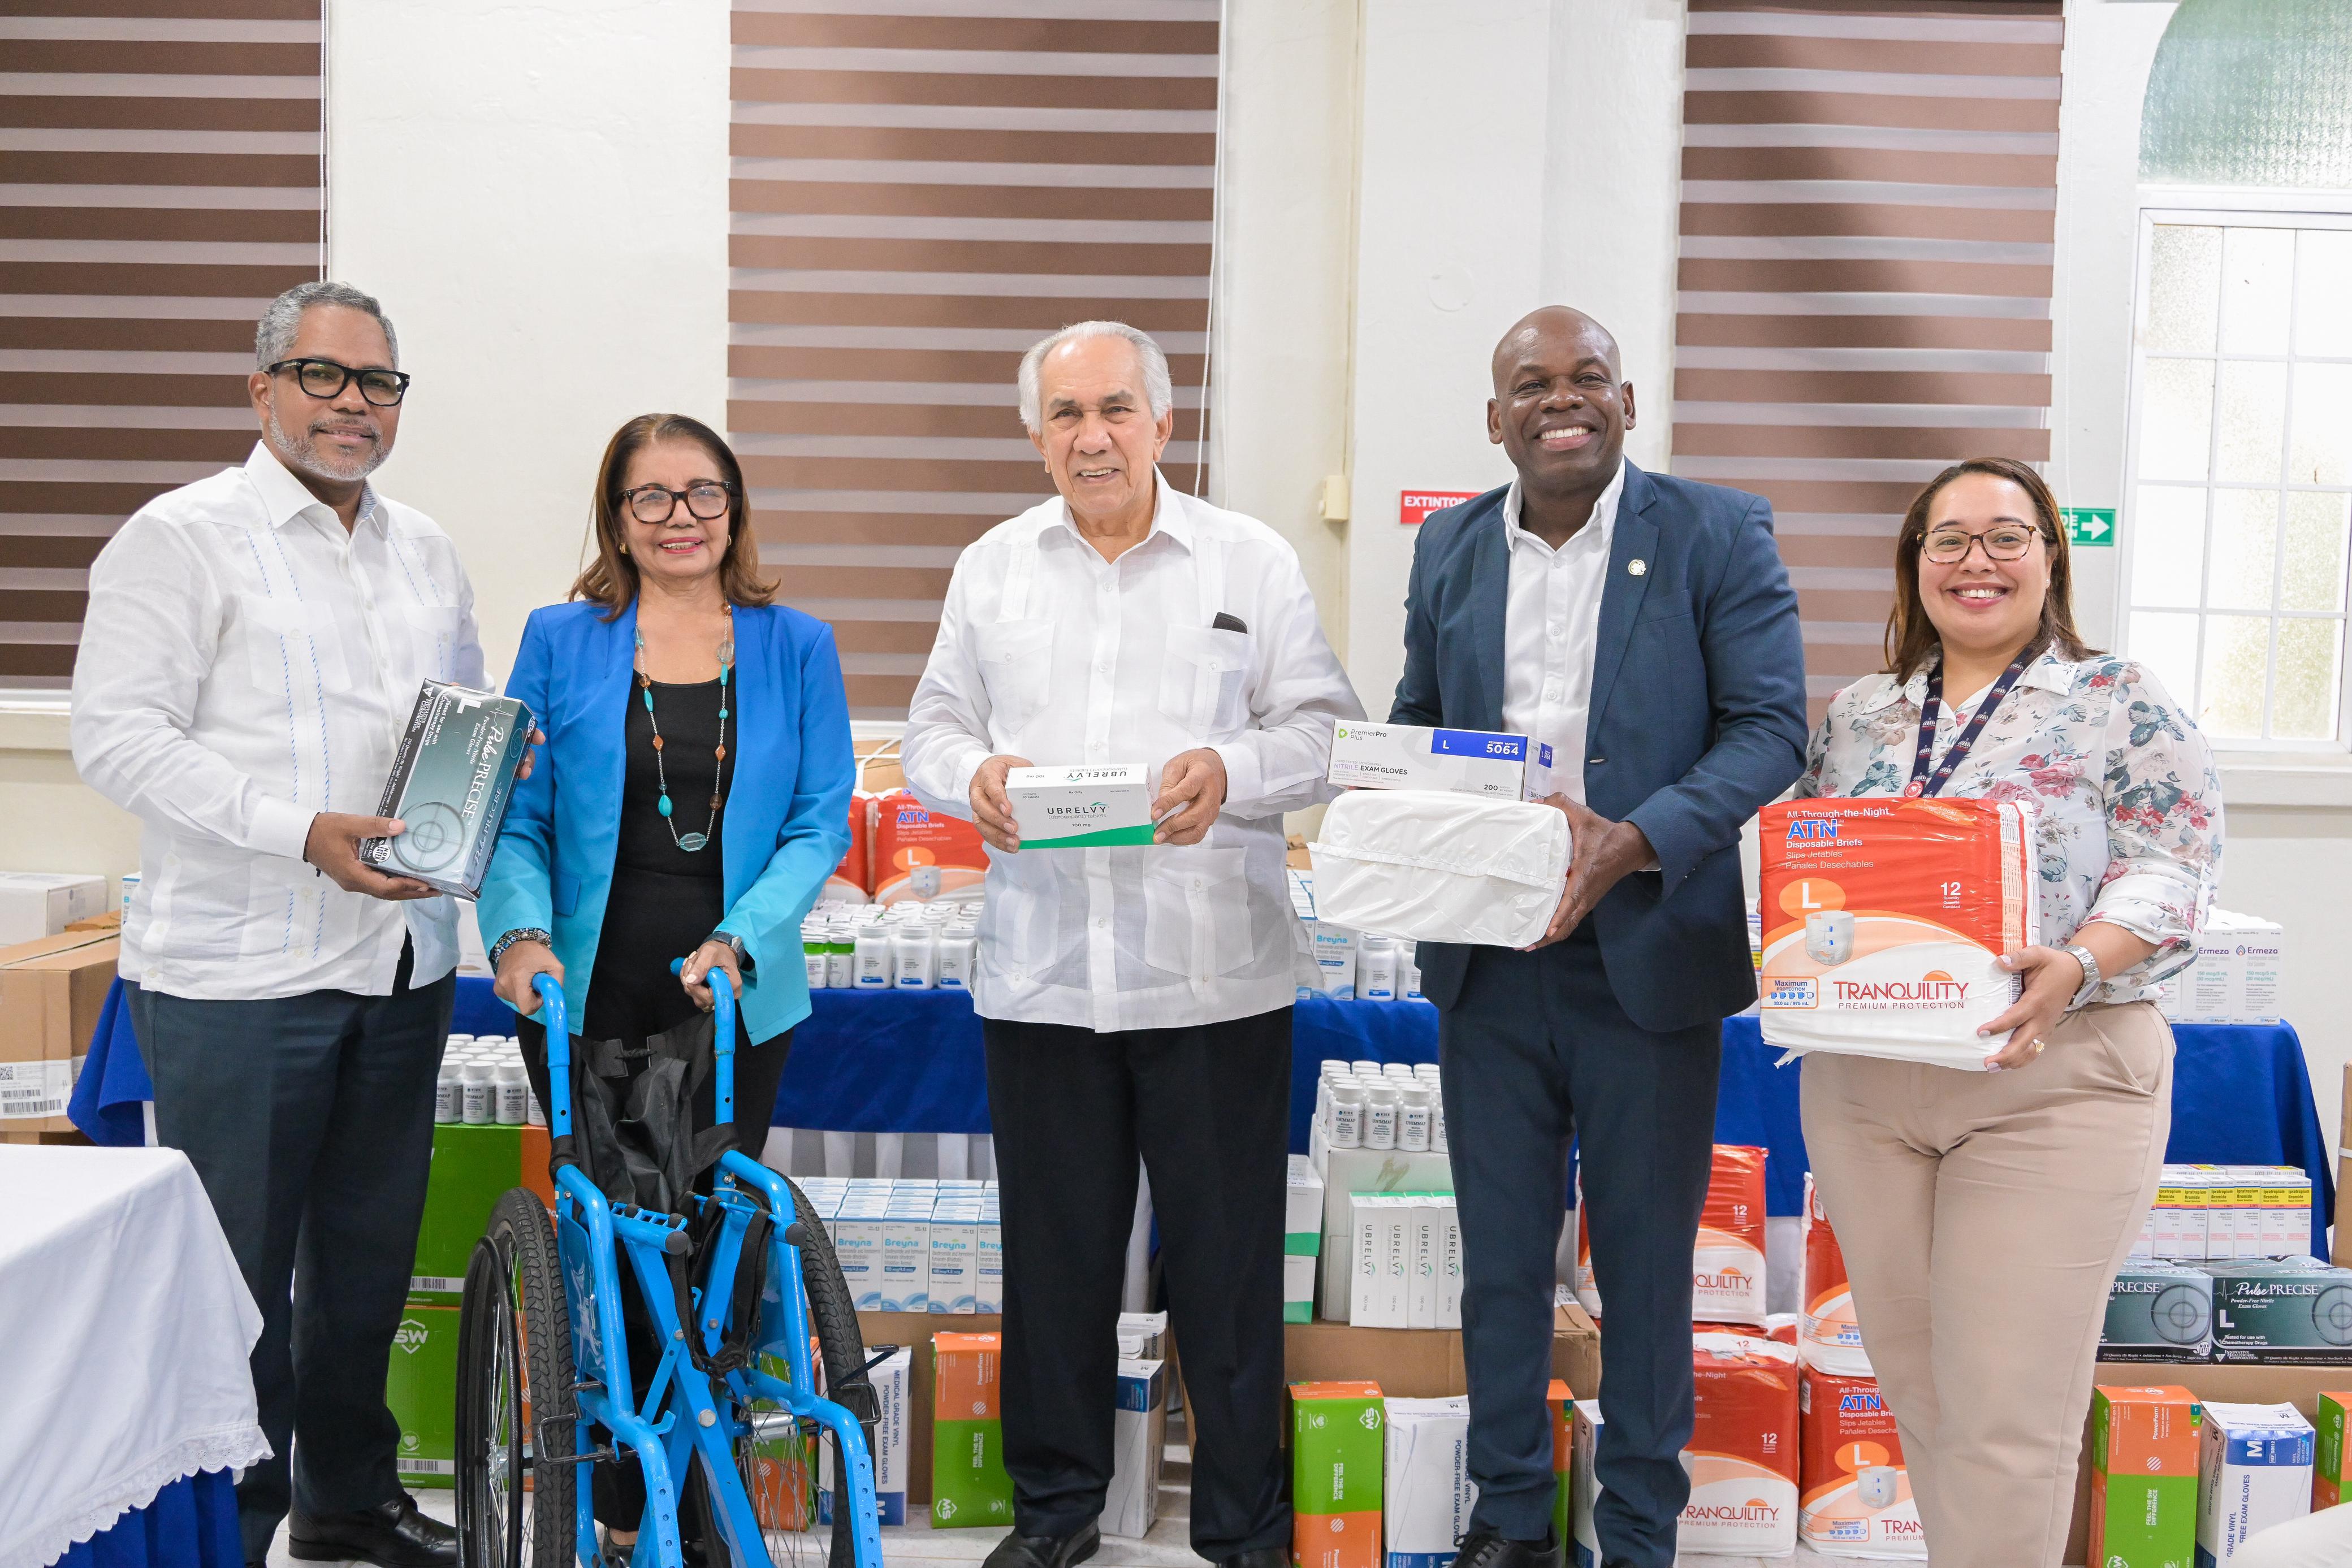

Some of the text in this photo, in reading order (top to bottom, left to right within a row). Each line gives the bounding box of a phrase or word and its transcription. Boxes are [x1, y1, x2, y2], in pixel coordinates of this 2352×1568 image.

[457, 698, 482, 714] L
[425, 696, 447, 746] Chemotherapy Drugs
[466, 722, 481, 755] Exam Gloves
[476, 716, 490, 747] Powder-Free
[1351, 729, 1387, 738] PremierPro
[1442, 739, 1450, 750] L
[1486, 744, 1519, 755] 5064
[461, 726, 504, 819] Pulse PRECISE
[1381, 767, 1408, 776] GLOVES
[484, 788, 502, 835] PRECISE
[896, 811, 929, 824] ATN
[1047, 806, 1107, 815] UBRELVY
[1787, 807, 1890, 818] All-Through-the-Night
[1786, 818, 1838, 839] ATN
[1786, 839, 1863, 850] Disposable Briefs
[907, 849, 920, 865] L
[1786, 850, 1843, 860] Slips Jetables
[1820, 860, 1874, 869] Desechables
[1802, 882, 1821, 909] L
[1940, 881, 1962, 896] 12
[1317, 935, 1348, 945] Breyna
[2198, 947, 2230, 955] Ermeza
[1833, 981, 1969, 1000] TRANQUILITY
[1732, 1205, 1748, 1215] 12
[838, 1238, 872, 1248] Breyna
[885, 1238, 919, 1248] Breyna
[932, 1241, 966, 1251] Breyna
[1364, 1224, 1372, 1275] UBRELVY
[1393, 1225, 1401, 1276] UBRELVY
[1420, 1225, 1429, 1276] UBRELVY
[1448, 1226, 1457, 1277] UBRELVY
[1694, 1274, 1752, 1289] QUILITY
[2111, 1282, 2160, 1293] PRECISE
[2236, 1282, 2319, 1295] Pulse PRECISE
[2219, 1309, 2234, 1328] L
[394, 1329, 429, 1344] SW
[1839, 1394, 1881, 1411] ATN
[1365, 1407, 1375, 1430] SW
[1761, 1433, 1778, 1444] 12
[1854, 1444, 1870, 1466] L
[2247, 1440, 2262, 1457] M
[2147, 1489, 2152, 1498] SW
